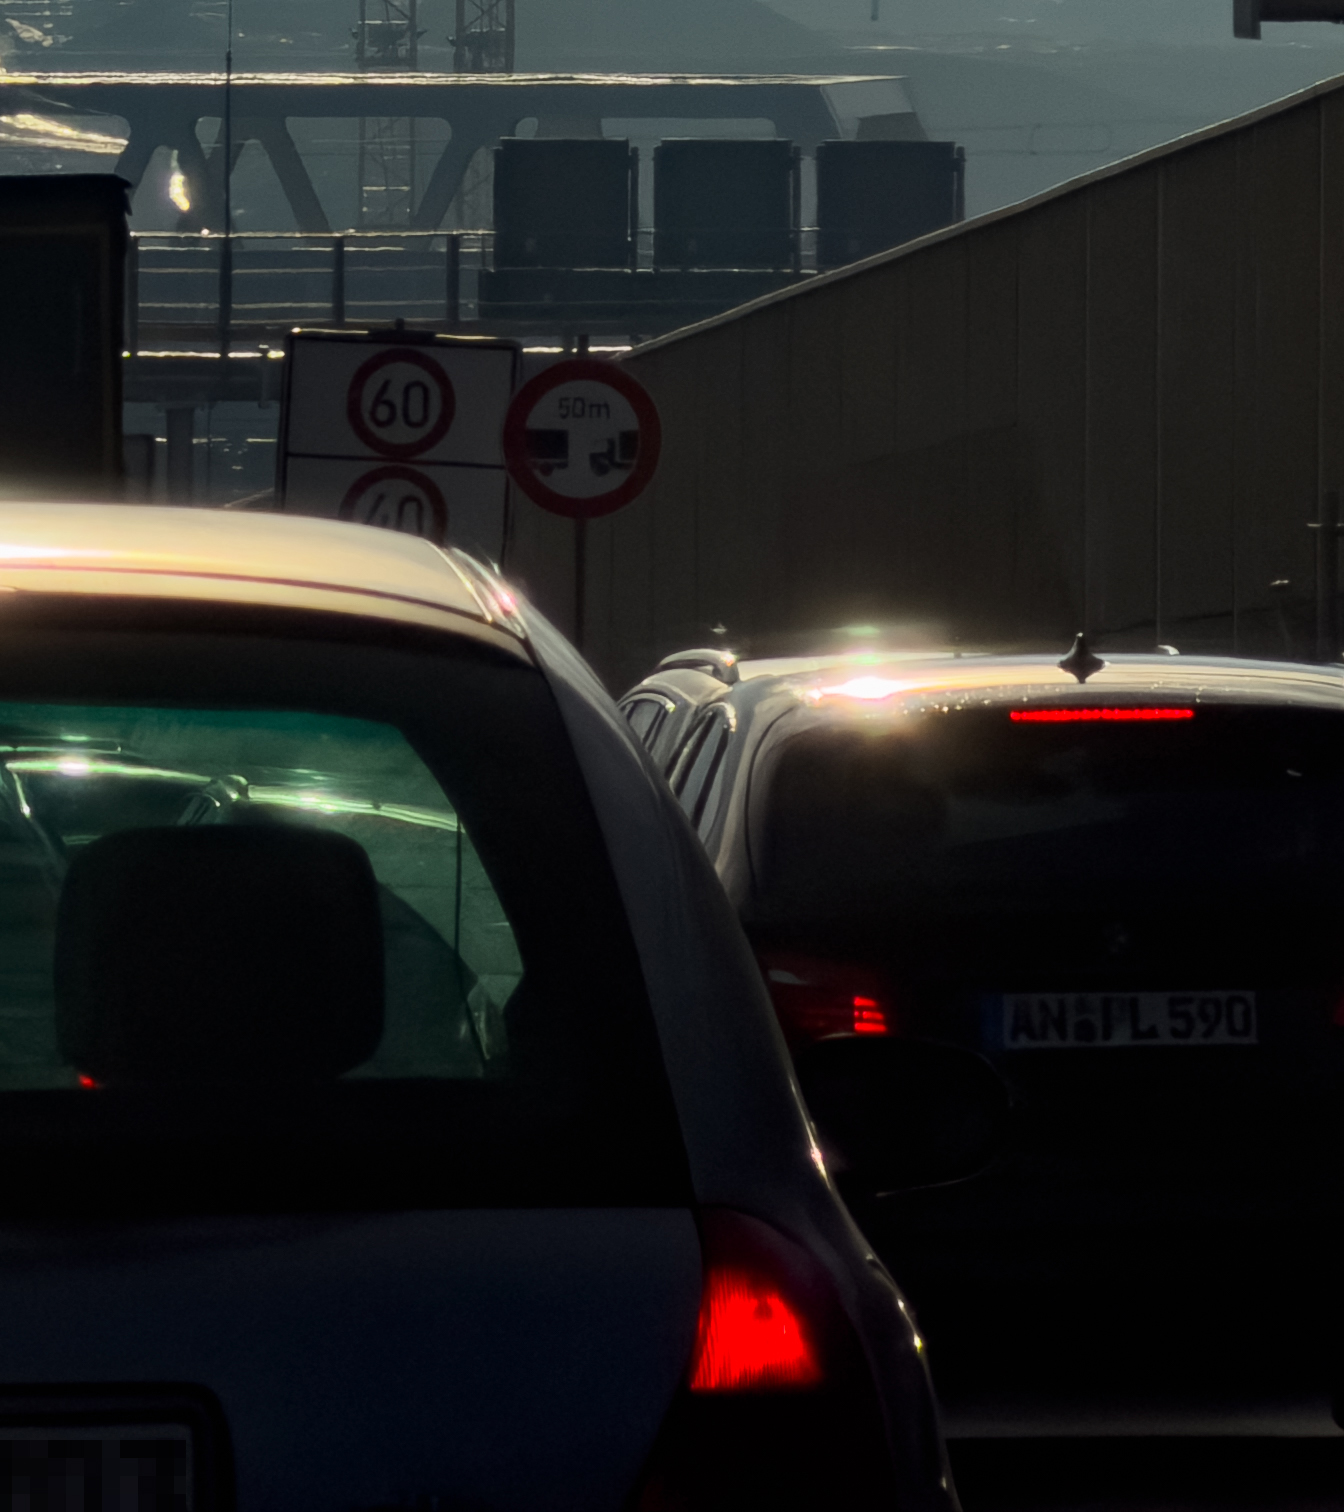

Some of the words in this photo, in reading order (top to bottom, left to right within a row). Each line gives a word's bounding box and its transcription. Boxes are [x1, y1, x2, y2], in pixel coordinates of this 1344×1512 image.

[369, 380, 430, 428] 60
[559, 397, 611, 420] 50m
[1012, 996, 1066, 1041] AN
[1168, 995, 1251, 1039] 590
